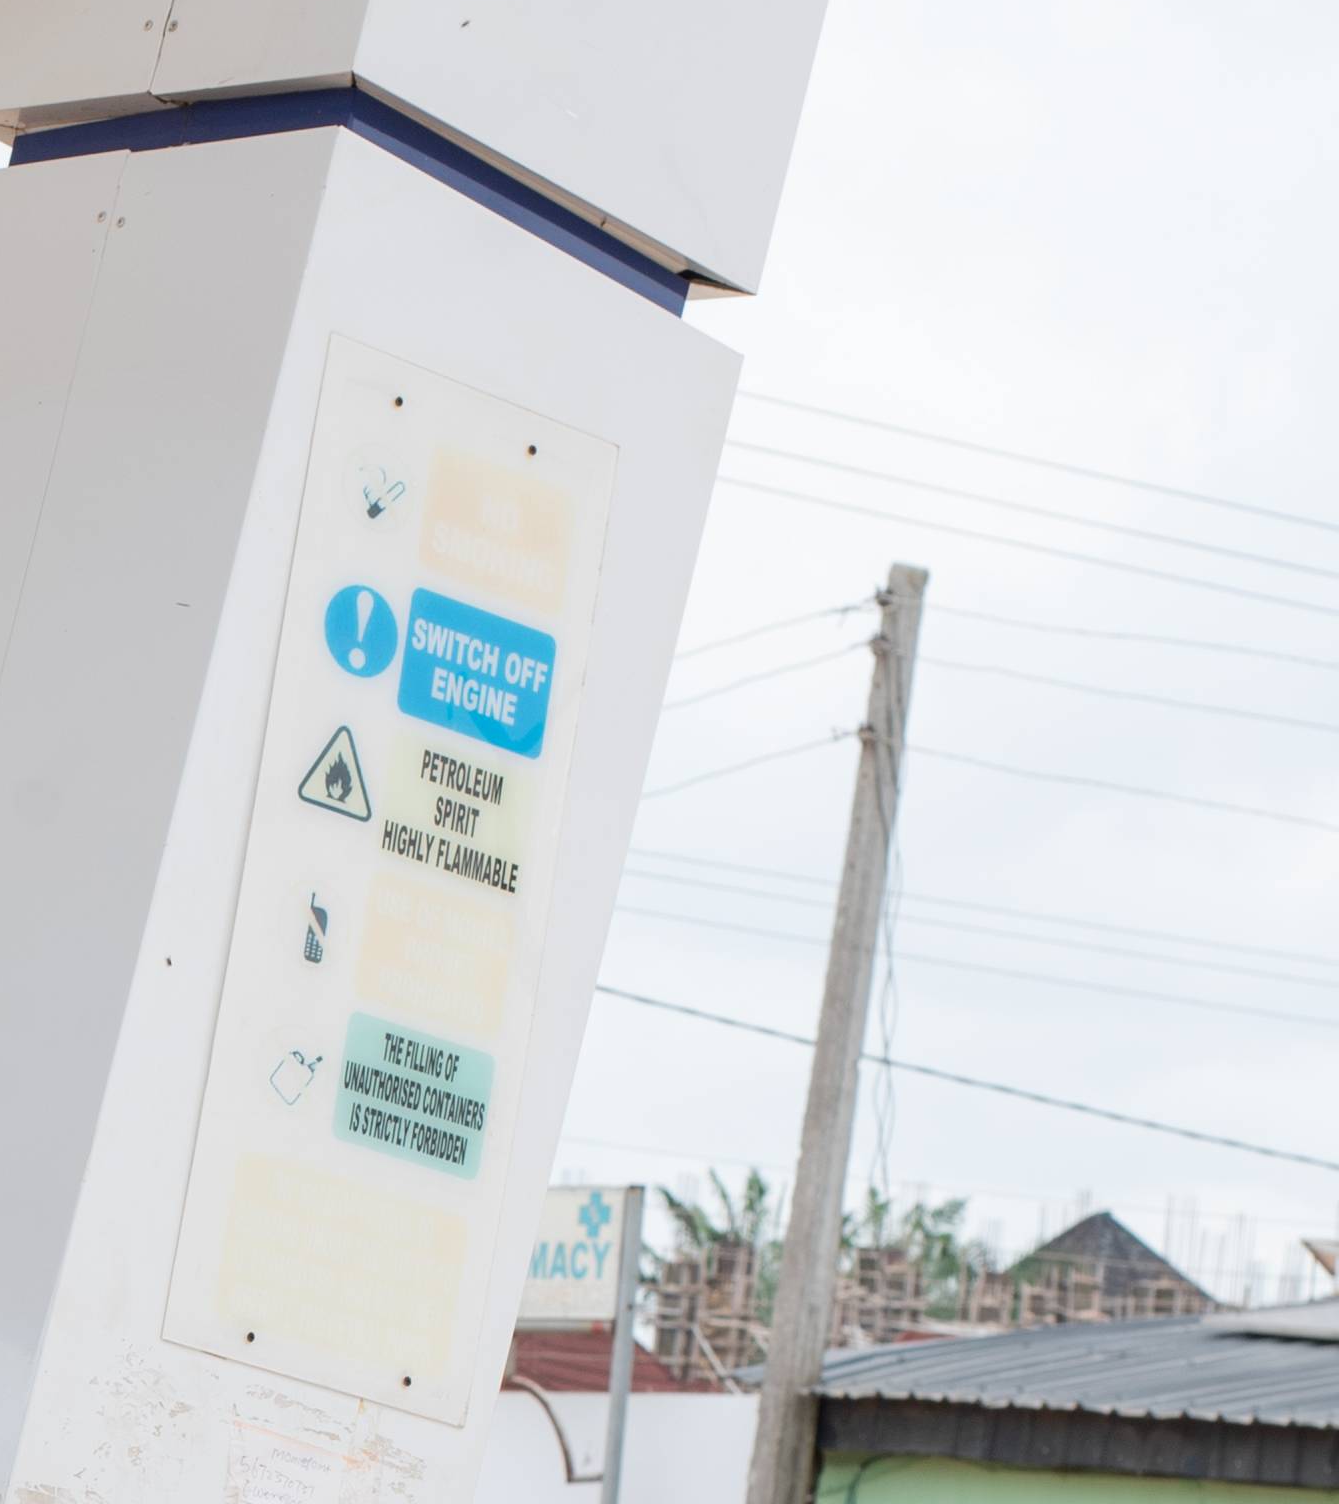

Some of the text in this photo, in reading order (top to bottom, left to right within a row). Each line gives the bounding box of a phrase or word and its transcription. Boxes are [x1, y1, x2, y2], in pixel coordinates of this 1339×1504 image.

[432, 521, 555, 593] SMOKING
[412, 618, 548, 692] SWITCH OFF
[431, 668, 517, 724] ENGINE
[421, 750, 503, 803] PETROLEUM
[434, 796, 479, 837] SPIRIT
[382, 820, 517, 892] HIGHLY FLAMMABLE
[383, 1032, 459, 1082] THE FILLING OF
[344, 1061, 484, 1130] UNAUTHORISED CONTAINERS
[349, 1102, 467, 1163] IS STRICTLY FORBIDDEN
